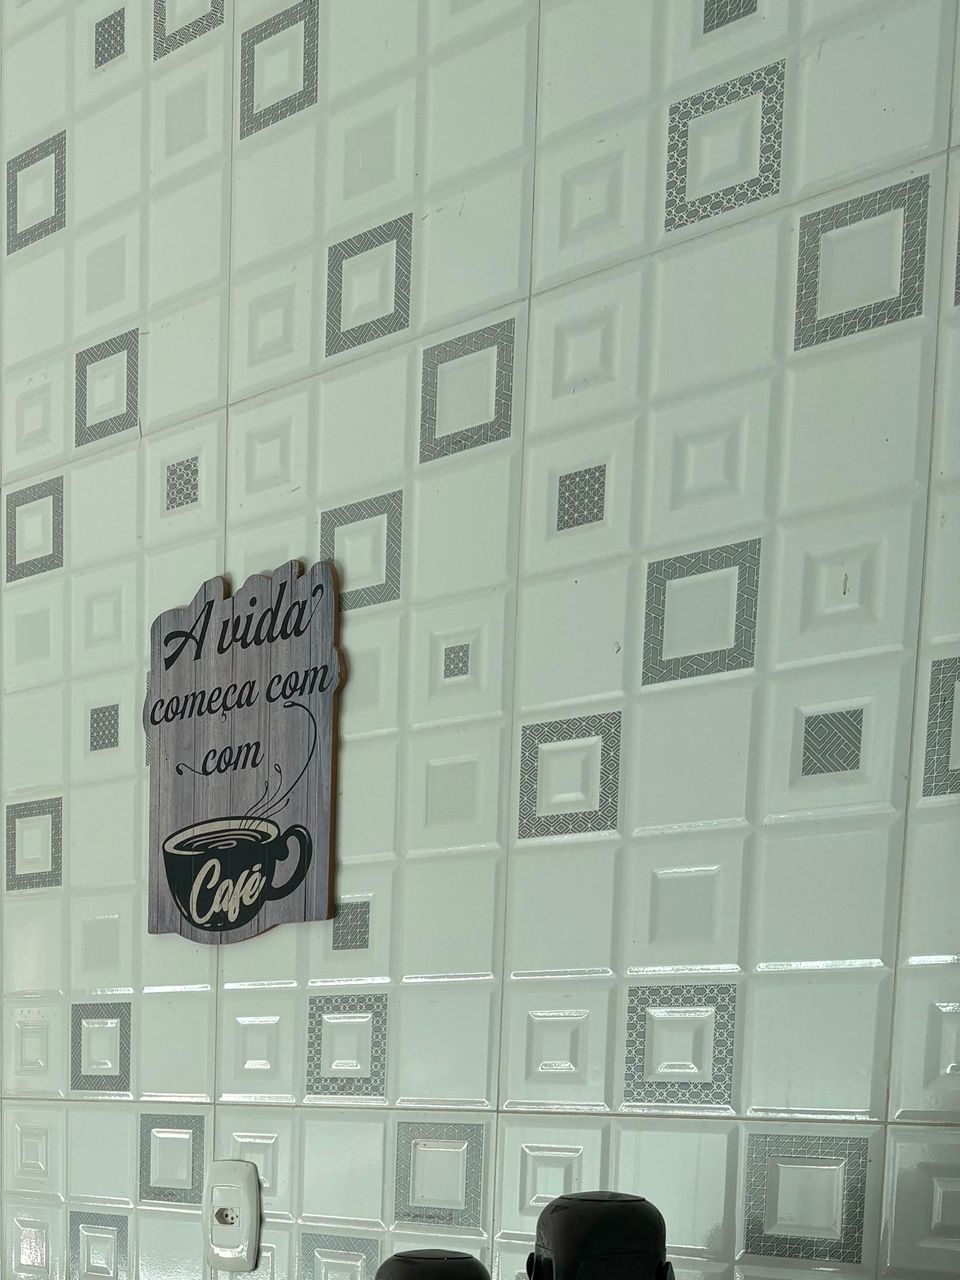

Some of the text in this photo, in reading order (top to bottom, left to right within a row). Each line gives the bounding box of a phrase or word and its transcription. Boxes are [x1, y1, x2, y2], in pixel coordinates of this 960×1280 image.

[163, 581, 324, 671] A vida
[149, 664, 333, 724] começa com
[176, 740, 265, 776] com
[190, 858, 267, 925] Café
